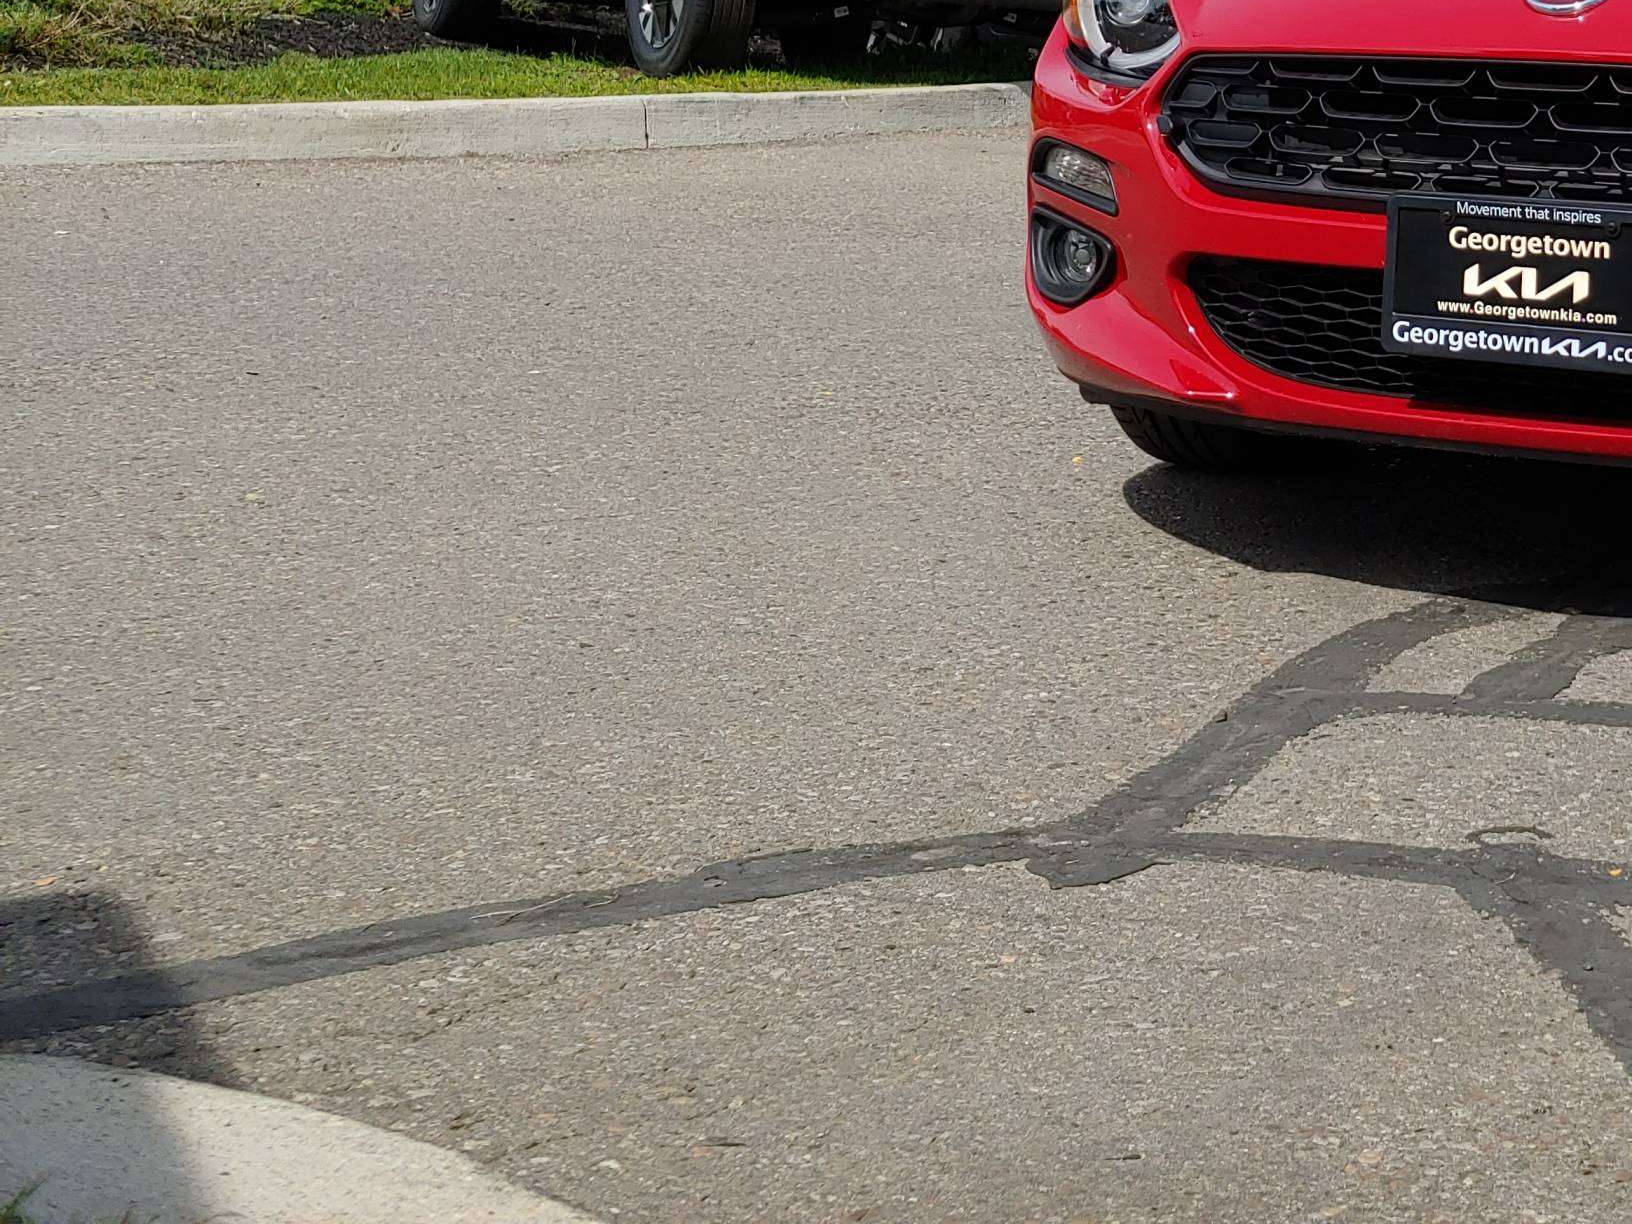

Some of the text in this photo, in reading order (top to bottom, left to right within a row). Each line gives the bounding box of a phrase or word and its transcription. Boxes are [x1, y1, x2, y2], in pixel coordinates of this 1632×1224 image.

[1456, 201, 1602, 224] Movement that inspires
[1448, 226, 1611, 260] Georgetown
[1437, 300, 1617, 325] www.Georgetownkia.com
